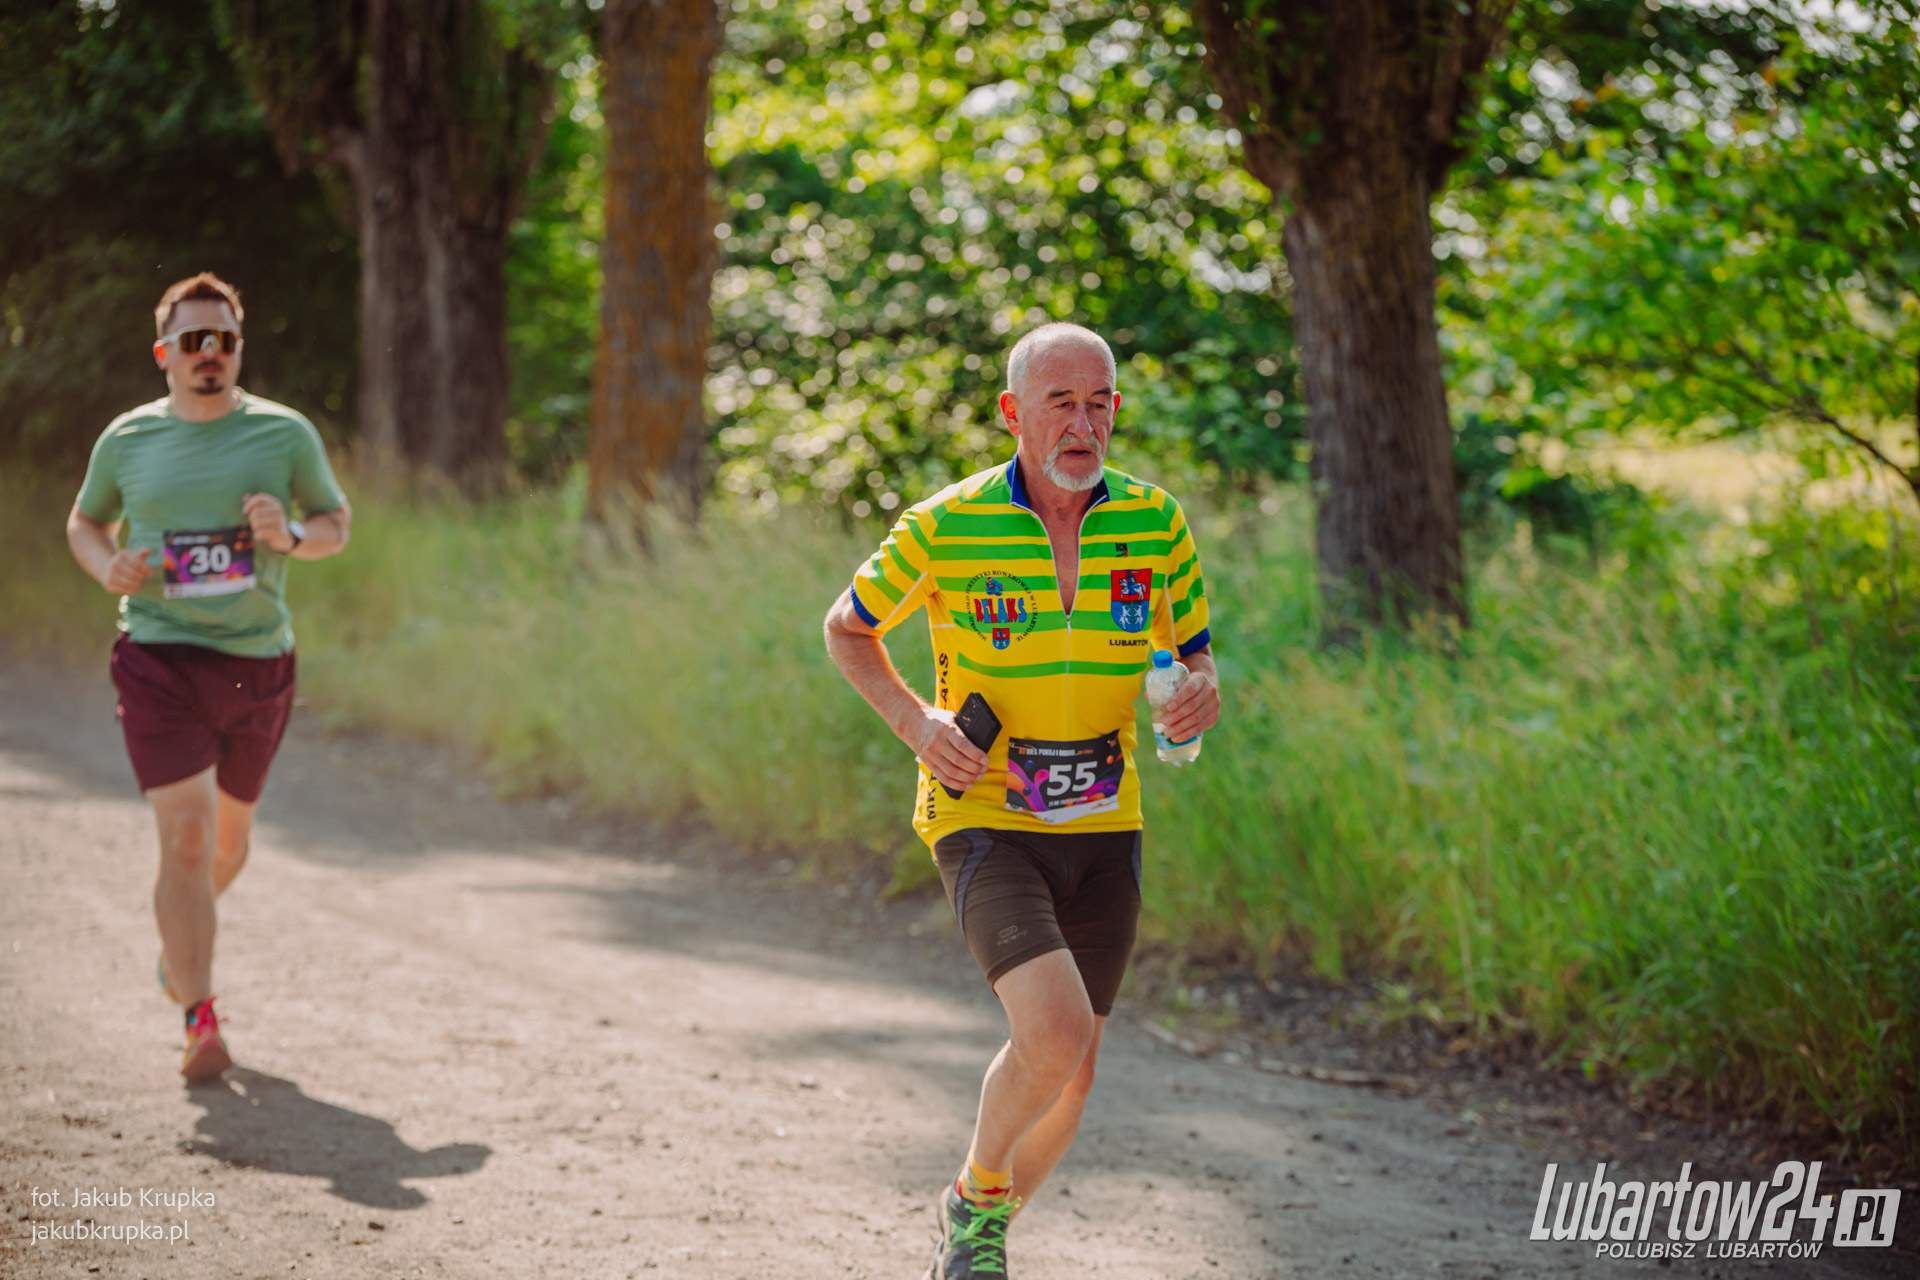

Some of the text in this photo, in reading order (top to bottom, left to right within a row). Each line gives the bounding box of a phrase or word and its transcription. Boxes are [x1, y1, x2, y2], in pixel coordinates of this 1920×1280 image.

[189, 544, 231, 574] 30
[973, 597, 1028, 625] RELAKS
[1046, 761, 1098, 796] 55
